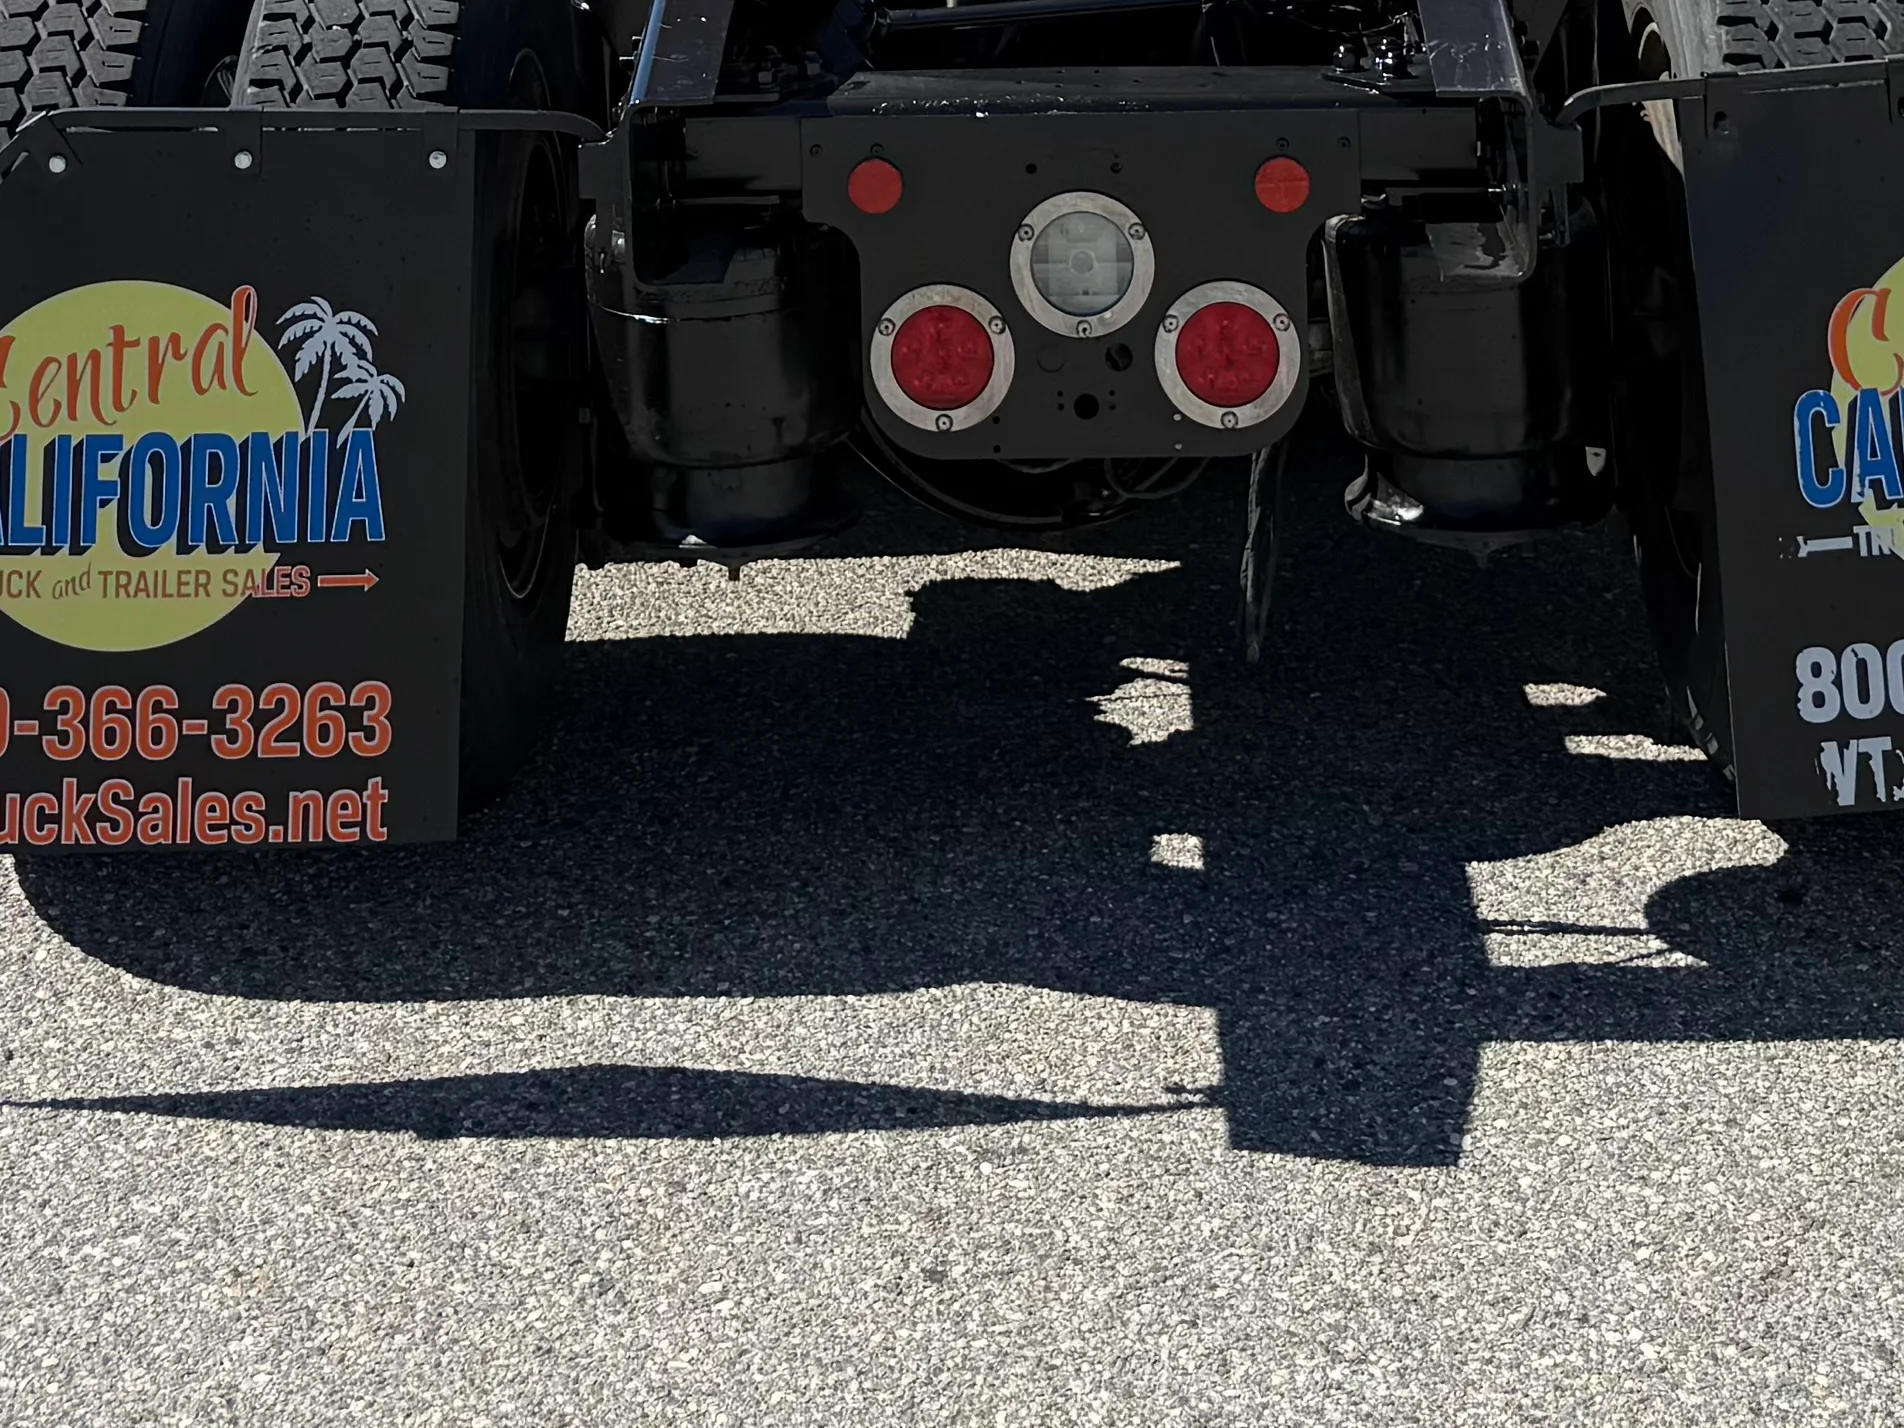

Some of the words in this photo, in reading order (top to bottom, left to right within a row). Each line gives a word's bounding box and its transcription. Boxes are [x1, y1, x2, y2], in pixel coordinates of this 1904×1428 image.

[52, 562, 93, 601] and
[98, 568, 211, 599] TRAILER
[220, 566, 313, 599] SALES
